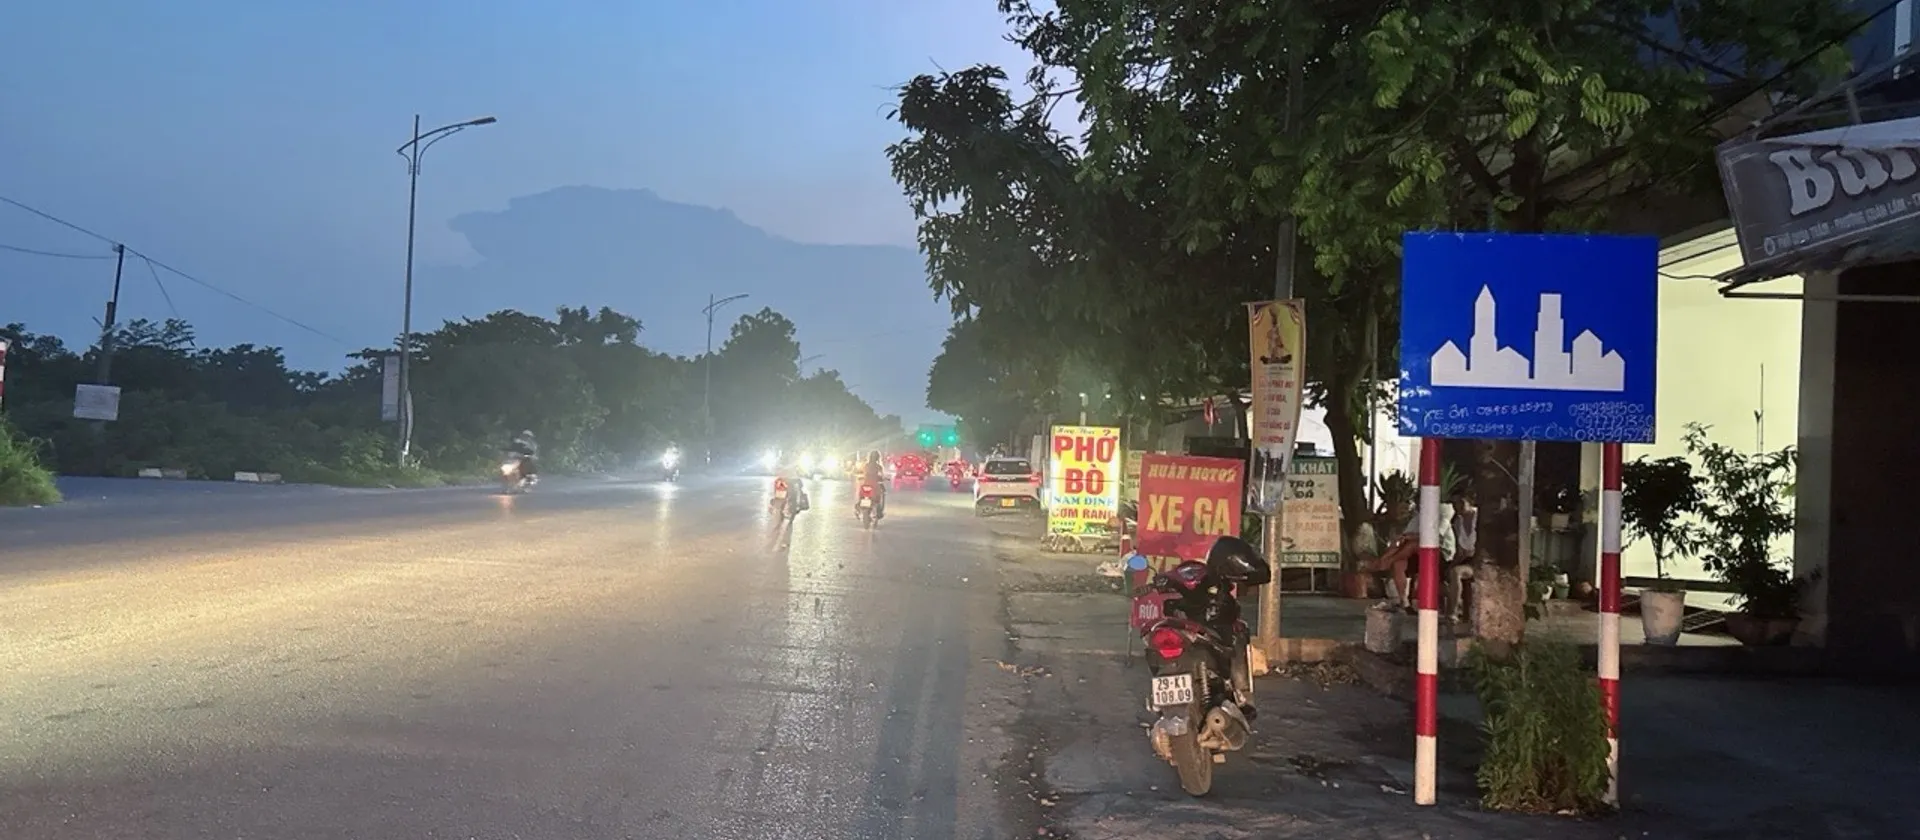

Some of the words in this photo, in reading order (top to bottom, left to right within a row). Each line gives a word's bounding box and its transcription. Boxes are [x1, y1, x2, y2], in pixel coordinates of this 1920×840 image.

[1054, 429, 1118, 463] PHỞ
[1065, 463, 1104, 495] BÒ
[1146, 493, 1184, 534] XE
[1193, 497, 1231, 536] GA
[1155, 688, 1191, 704] 108.09
[1157, 676, 1186, 691] 29-K1
